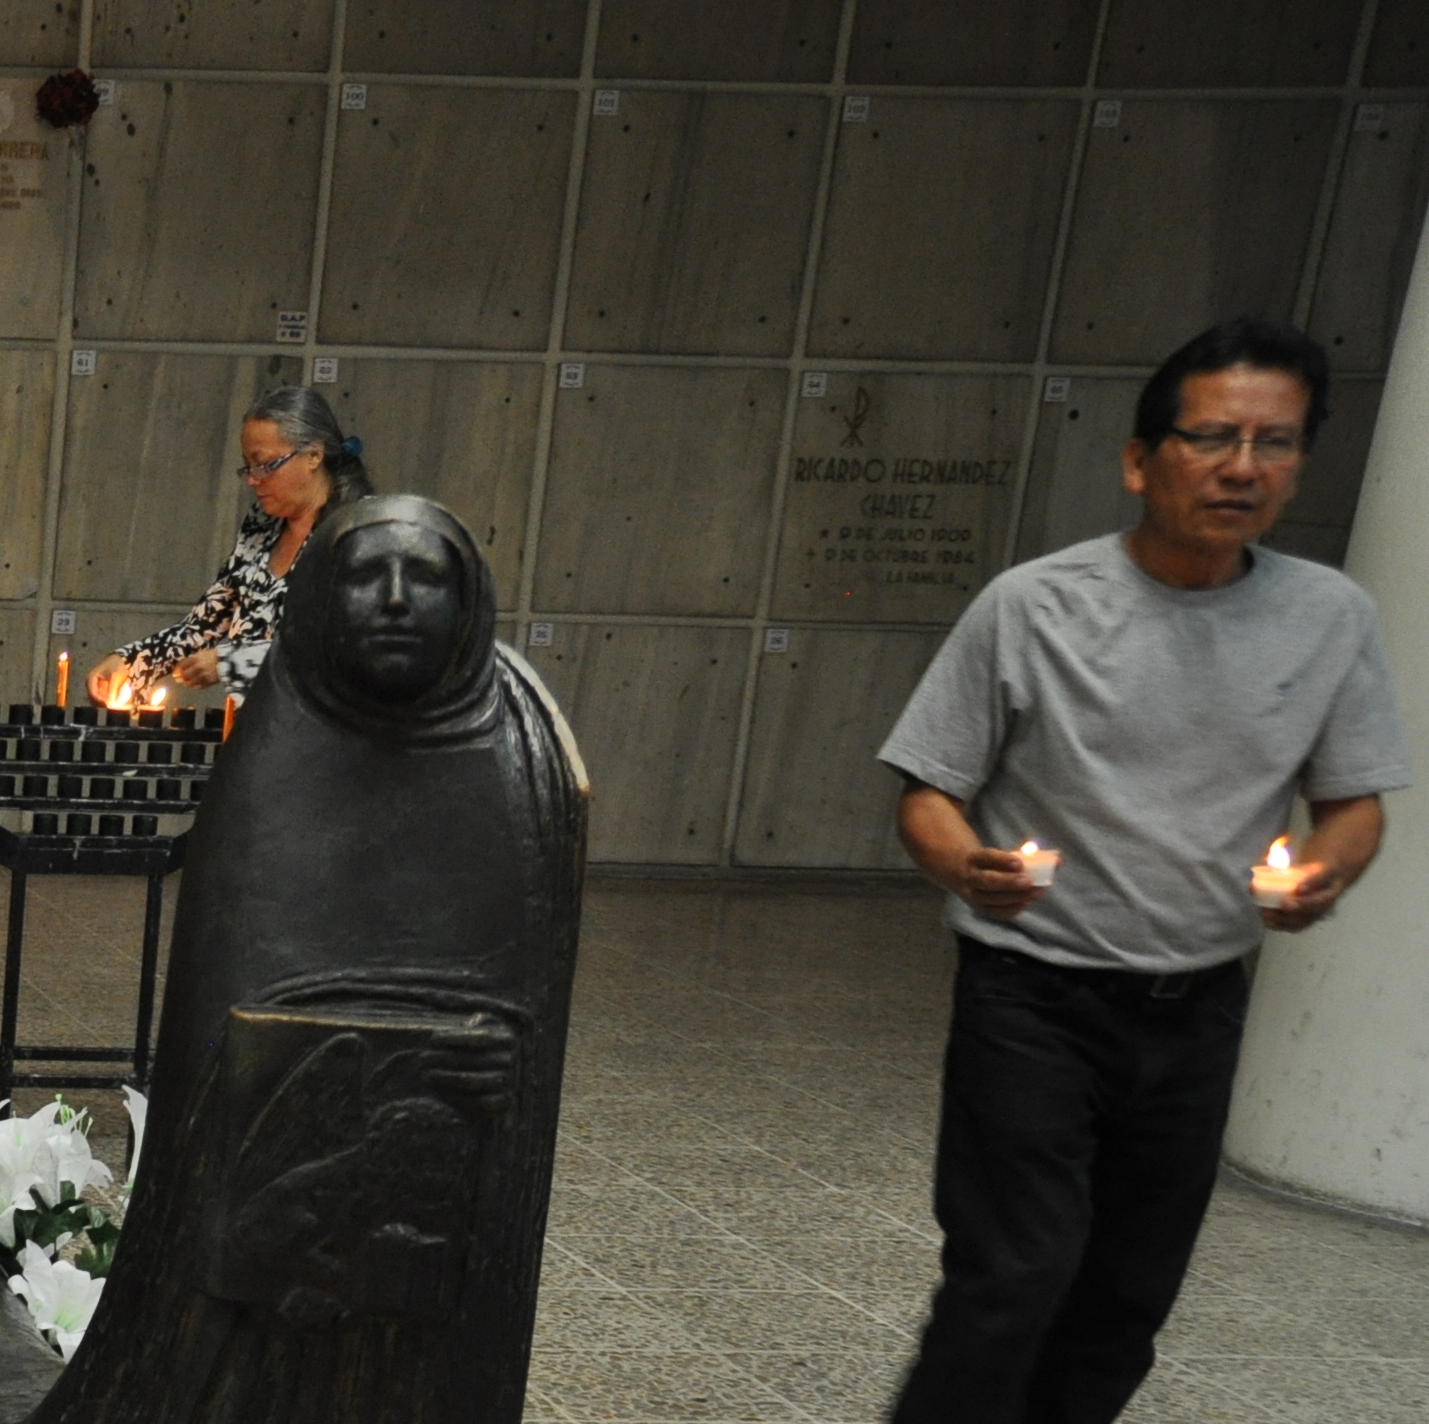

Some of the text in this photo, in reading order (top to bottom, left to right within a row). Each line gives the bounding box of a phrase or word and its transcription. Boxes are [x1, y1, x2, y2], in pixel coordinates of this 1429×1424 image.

[795, 457, 1014, 486] RICARDO HERNANDEZ
[860, 493, 937, 520] CHAVEZ
[880, 527, 926, 541] JULIO
[862, 548, 928, 564] OCTUBRE
